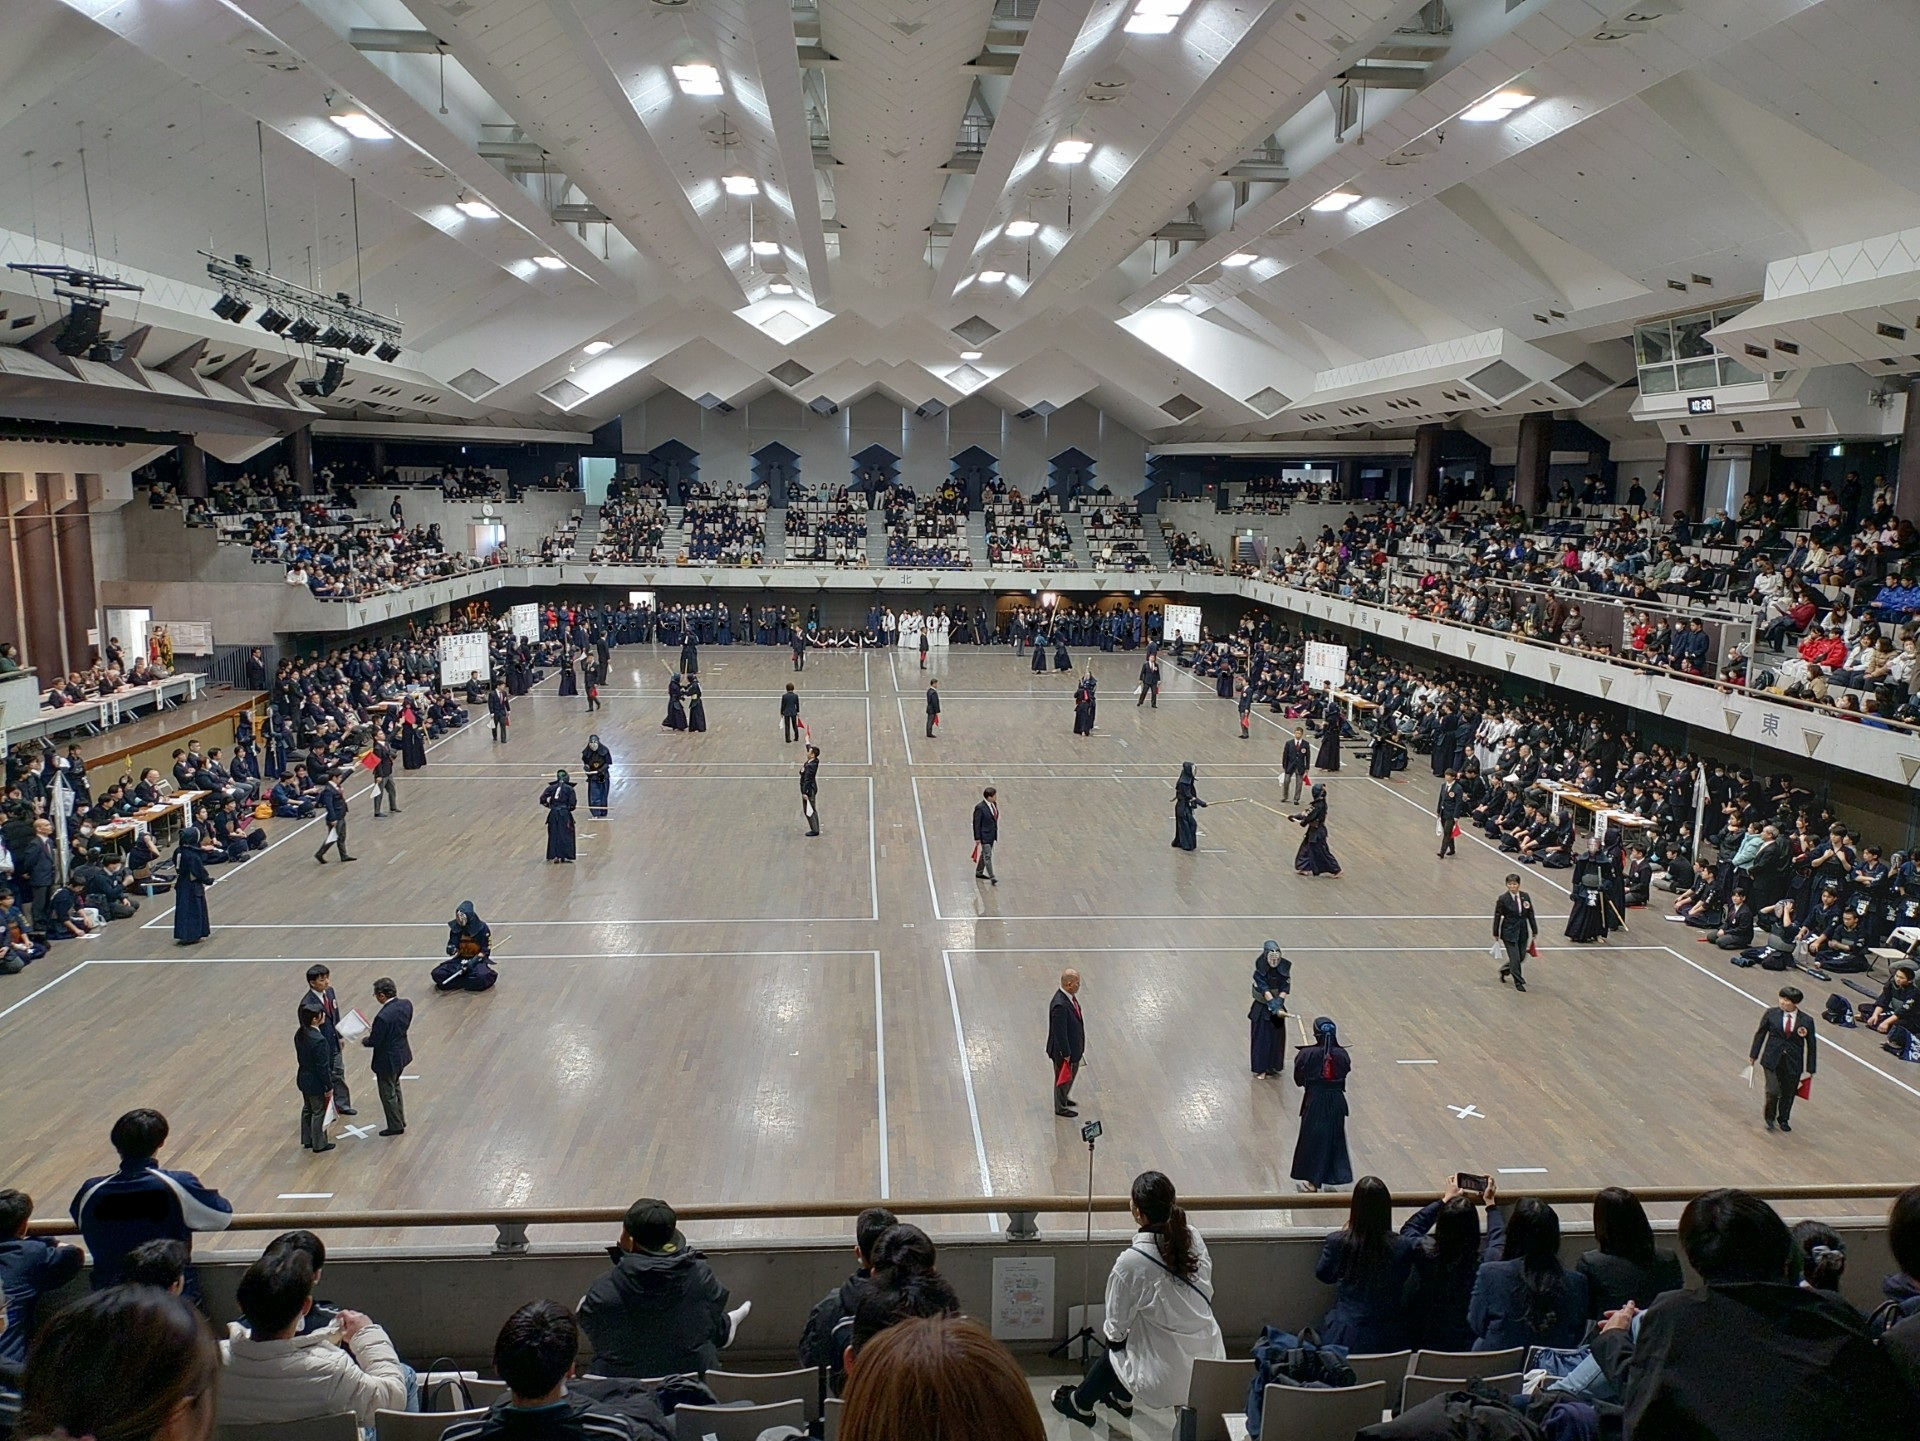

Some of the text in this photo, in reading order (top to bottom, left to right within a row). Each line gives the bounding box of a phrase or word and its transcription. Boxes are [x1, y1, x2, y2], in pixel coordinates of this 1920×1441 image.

[1691, 399, 1713, 411] 10:28
[900, 573, 912, 585] 北
[1360, 611, 1368, 625] 東
[1761, 712, 1781, 738] 東
